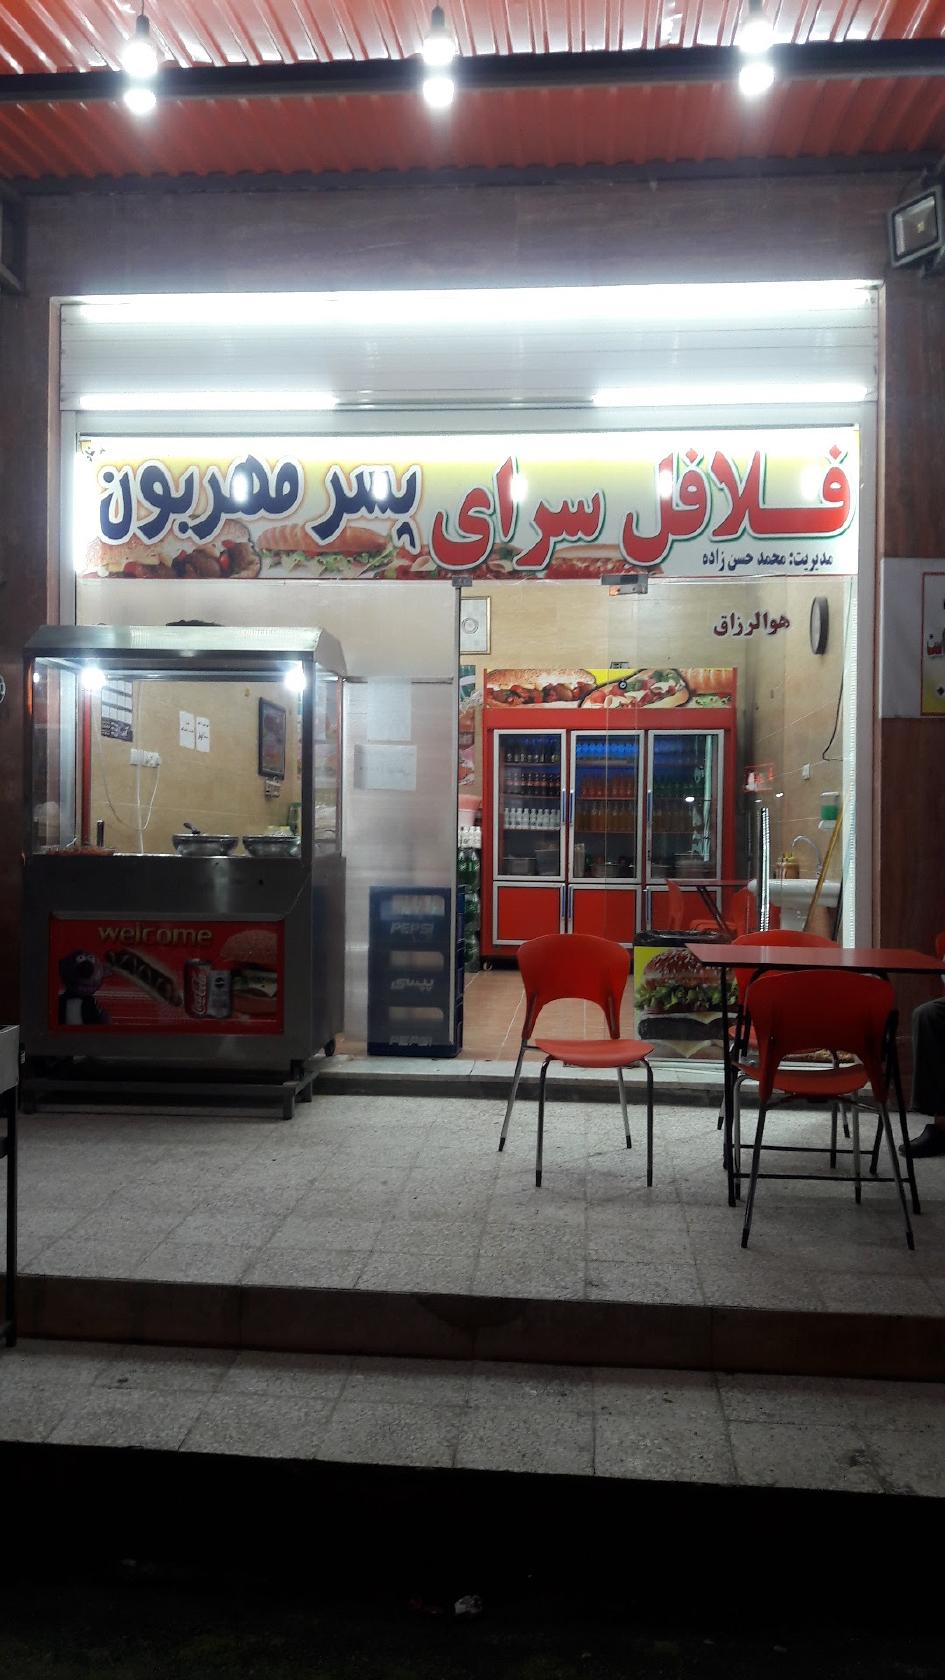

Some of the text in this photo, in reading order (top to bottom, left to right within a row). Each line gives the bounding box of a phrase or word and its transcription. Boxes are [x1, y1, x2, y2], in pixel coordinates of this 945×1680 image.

[99, 444, 851, 568] فلافل سرای پسر مهربون
[702, 548, 725, 571] زاده
[727, 552, 754, 571] حسن
[757, 551, 786, 566] محمد
[98, 924, 213, 944] welcome
